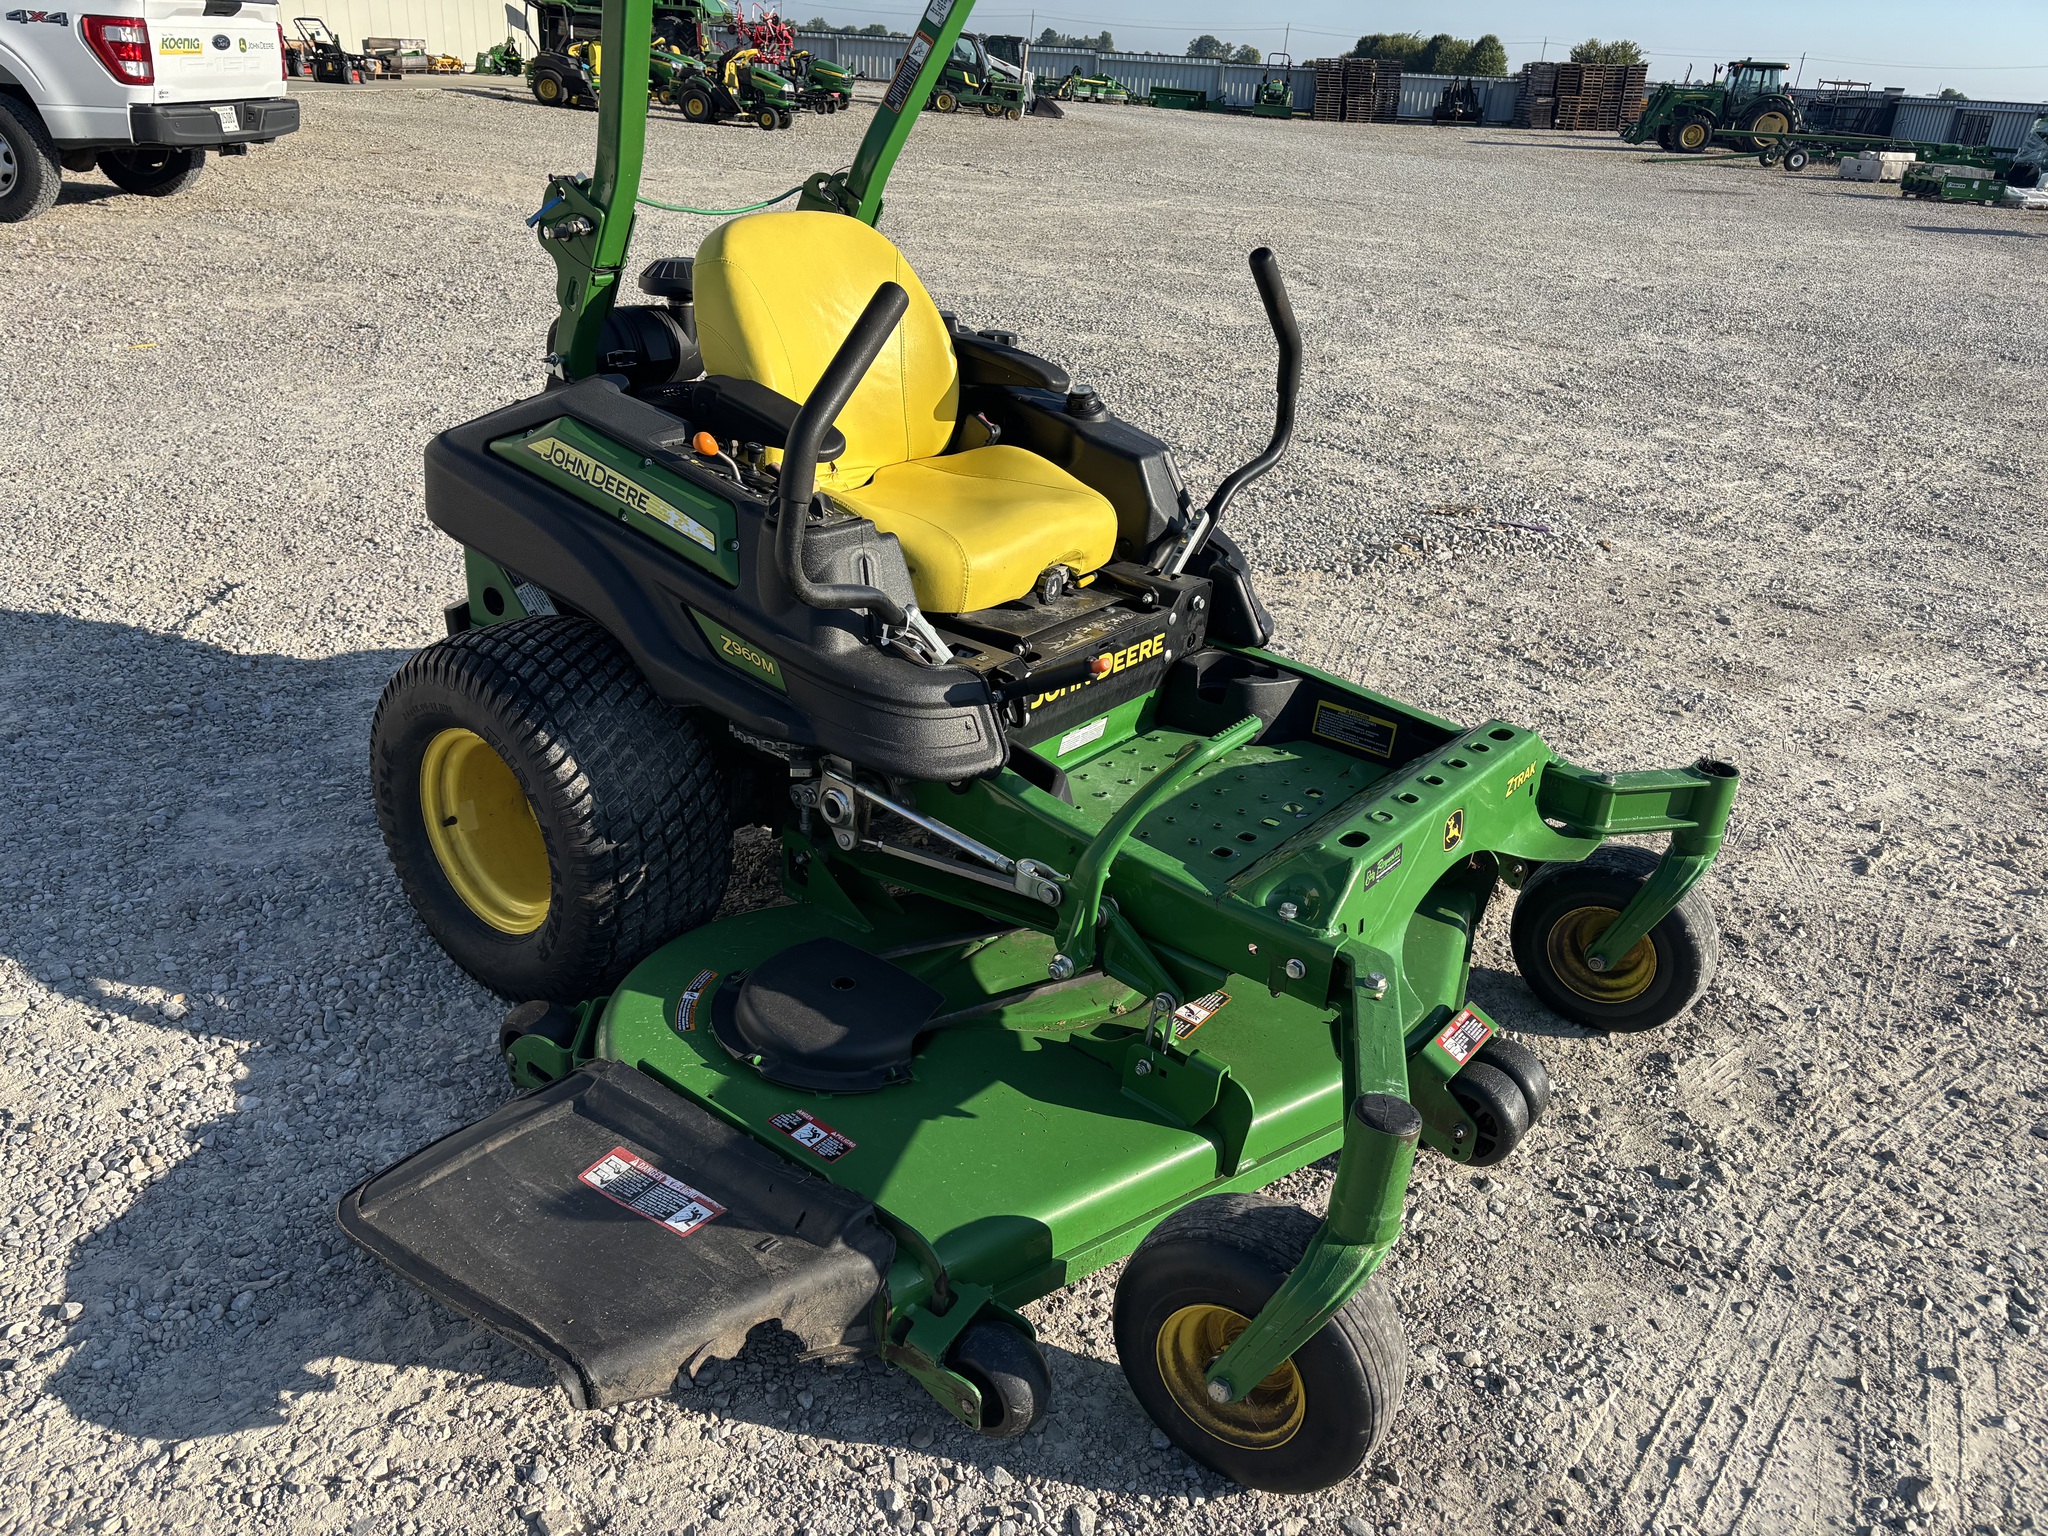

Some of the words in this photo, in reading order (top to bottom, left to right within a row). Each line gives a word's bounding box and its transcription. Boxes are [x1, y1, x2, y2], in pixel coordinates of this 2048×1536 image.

[543, 441, 590, 479] JOHN
[591, 463, 650, 512] DEERE
[720, 634, 775, 675] Z960M
[1097, 632, 1166, 680] DEERE
[1505, 759, 1537, 799] ZTRAK
[637, 1162, 666, 1181] DANGER
